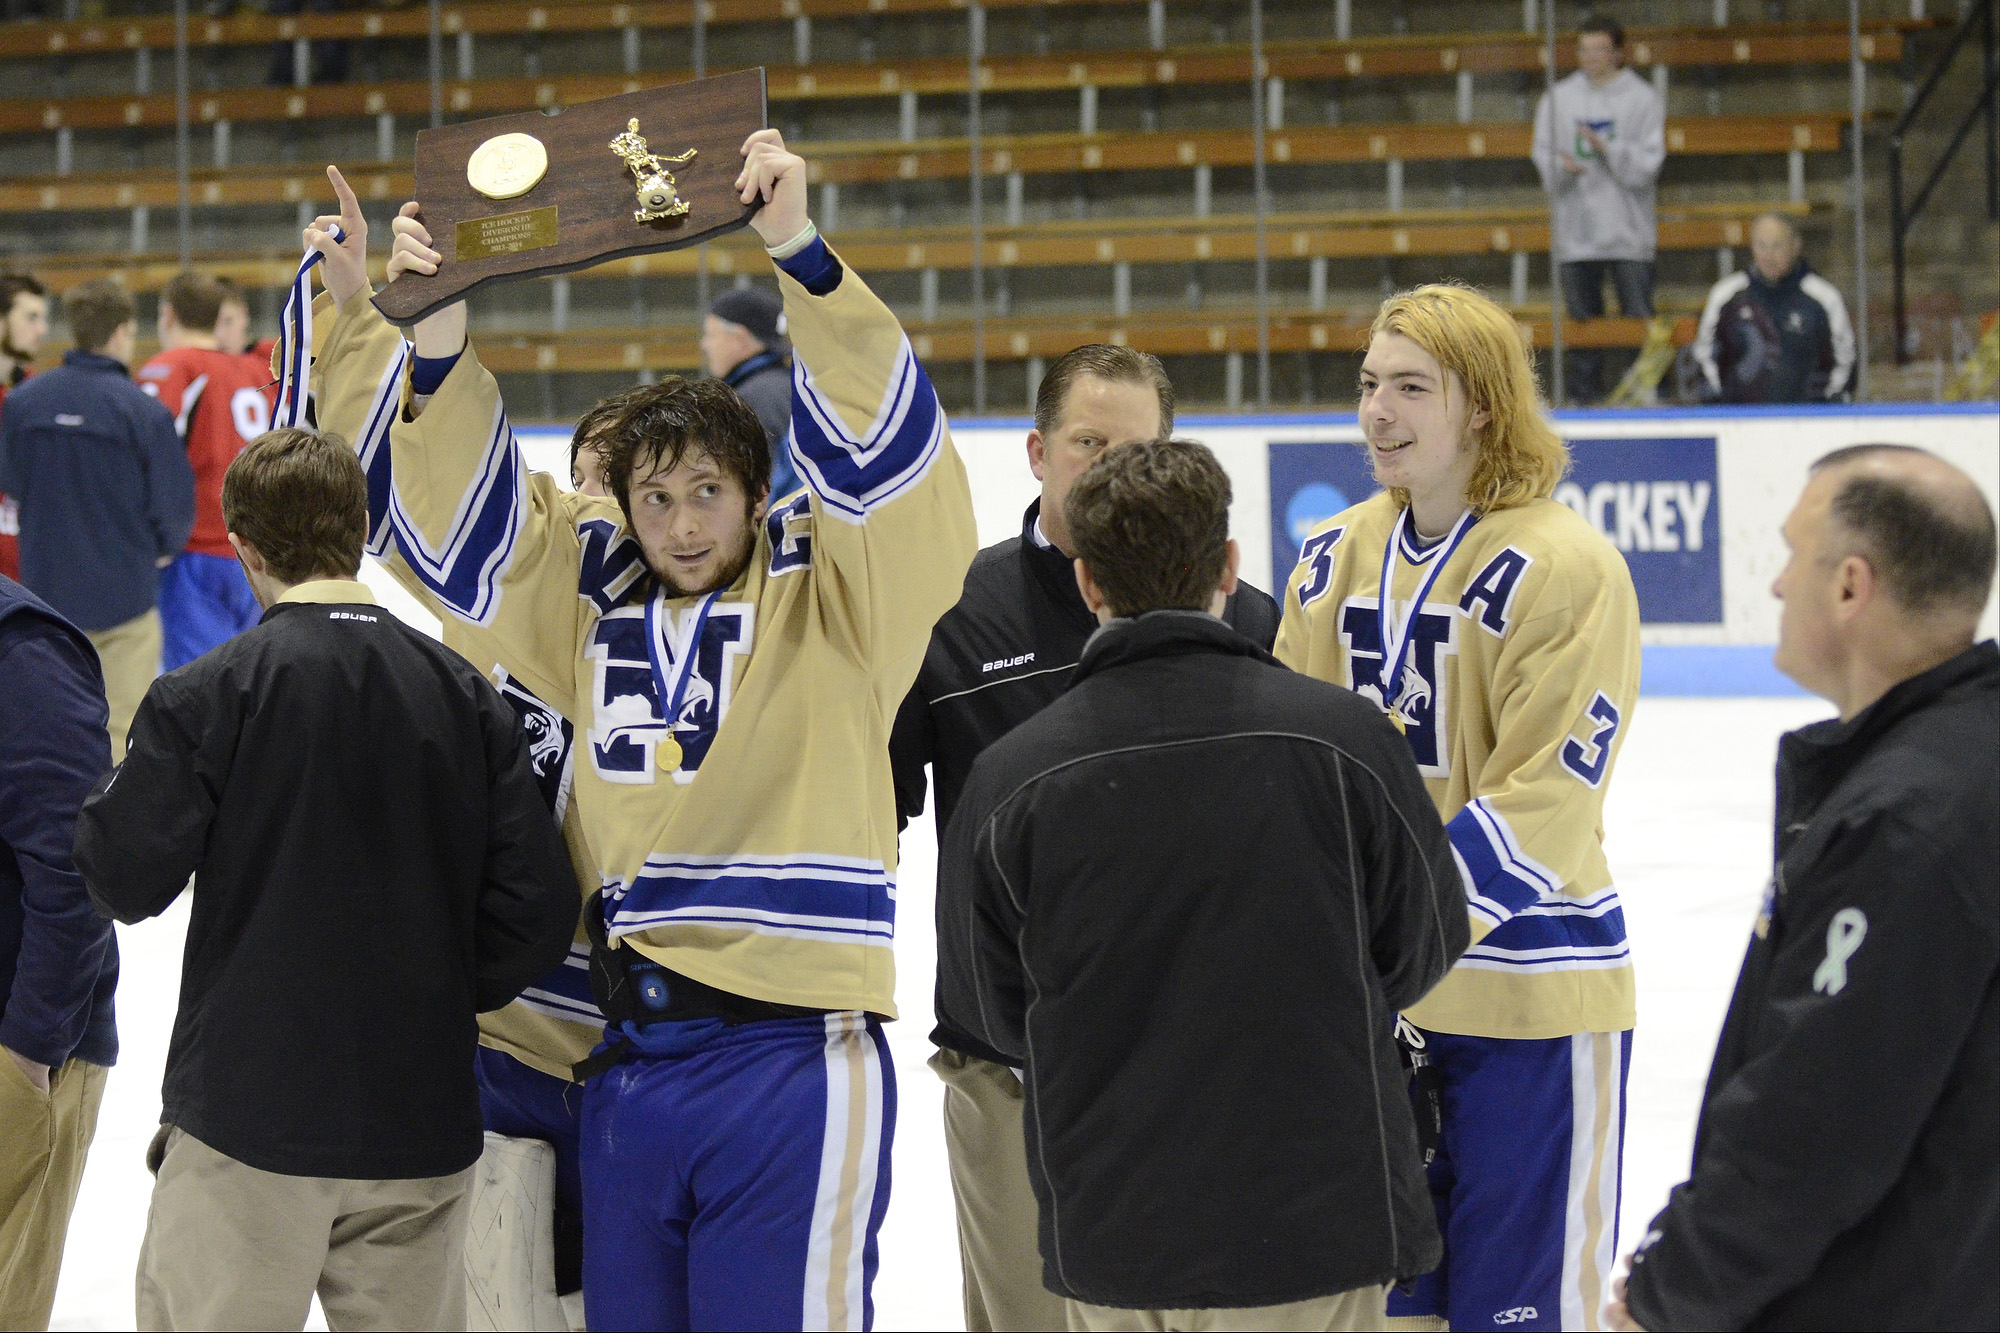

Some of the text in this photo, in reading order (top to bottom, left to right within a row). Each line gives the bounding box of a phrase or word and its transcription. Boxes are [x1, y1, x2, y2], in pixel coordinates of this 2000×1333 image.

[481, 215, 532, 229] ICE HOCKEY
[481, 231, 532, 246] CHAMPIONS
[482, 225, 520, 238] DIVISION
[1297, 524, 1348, 612] 3
[1458, 543, 1535, 639] A
[329, 611, 378, 624] BAUER
[981, 652, 1036, 673] BAUER
[1557, 687, 1621, 790] 3
